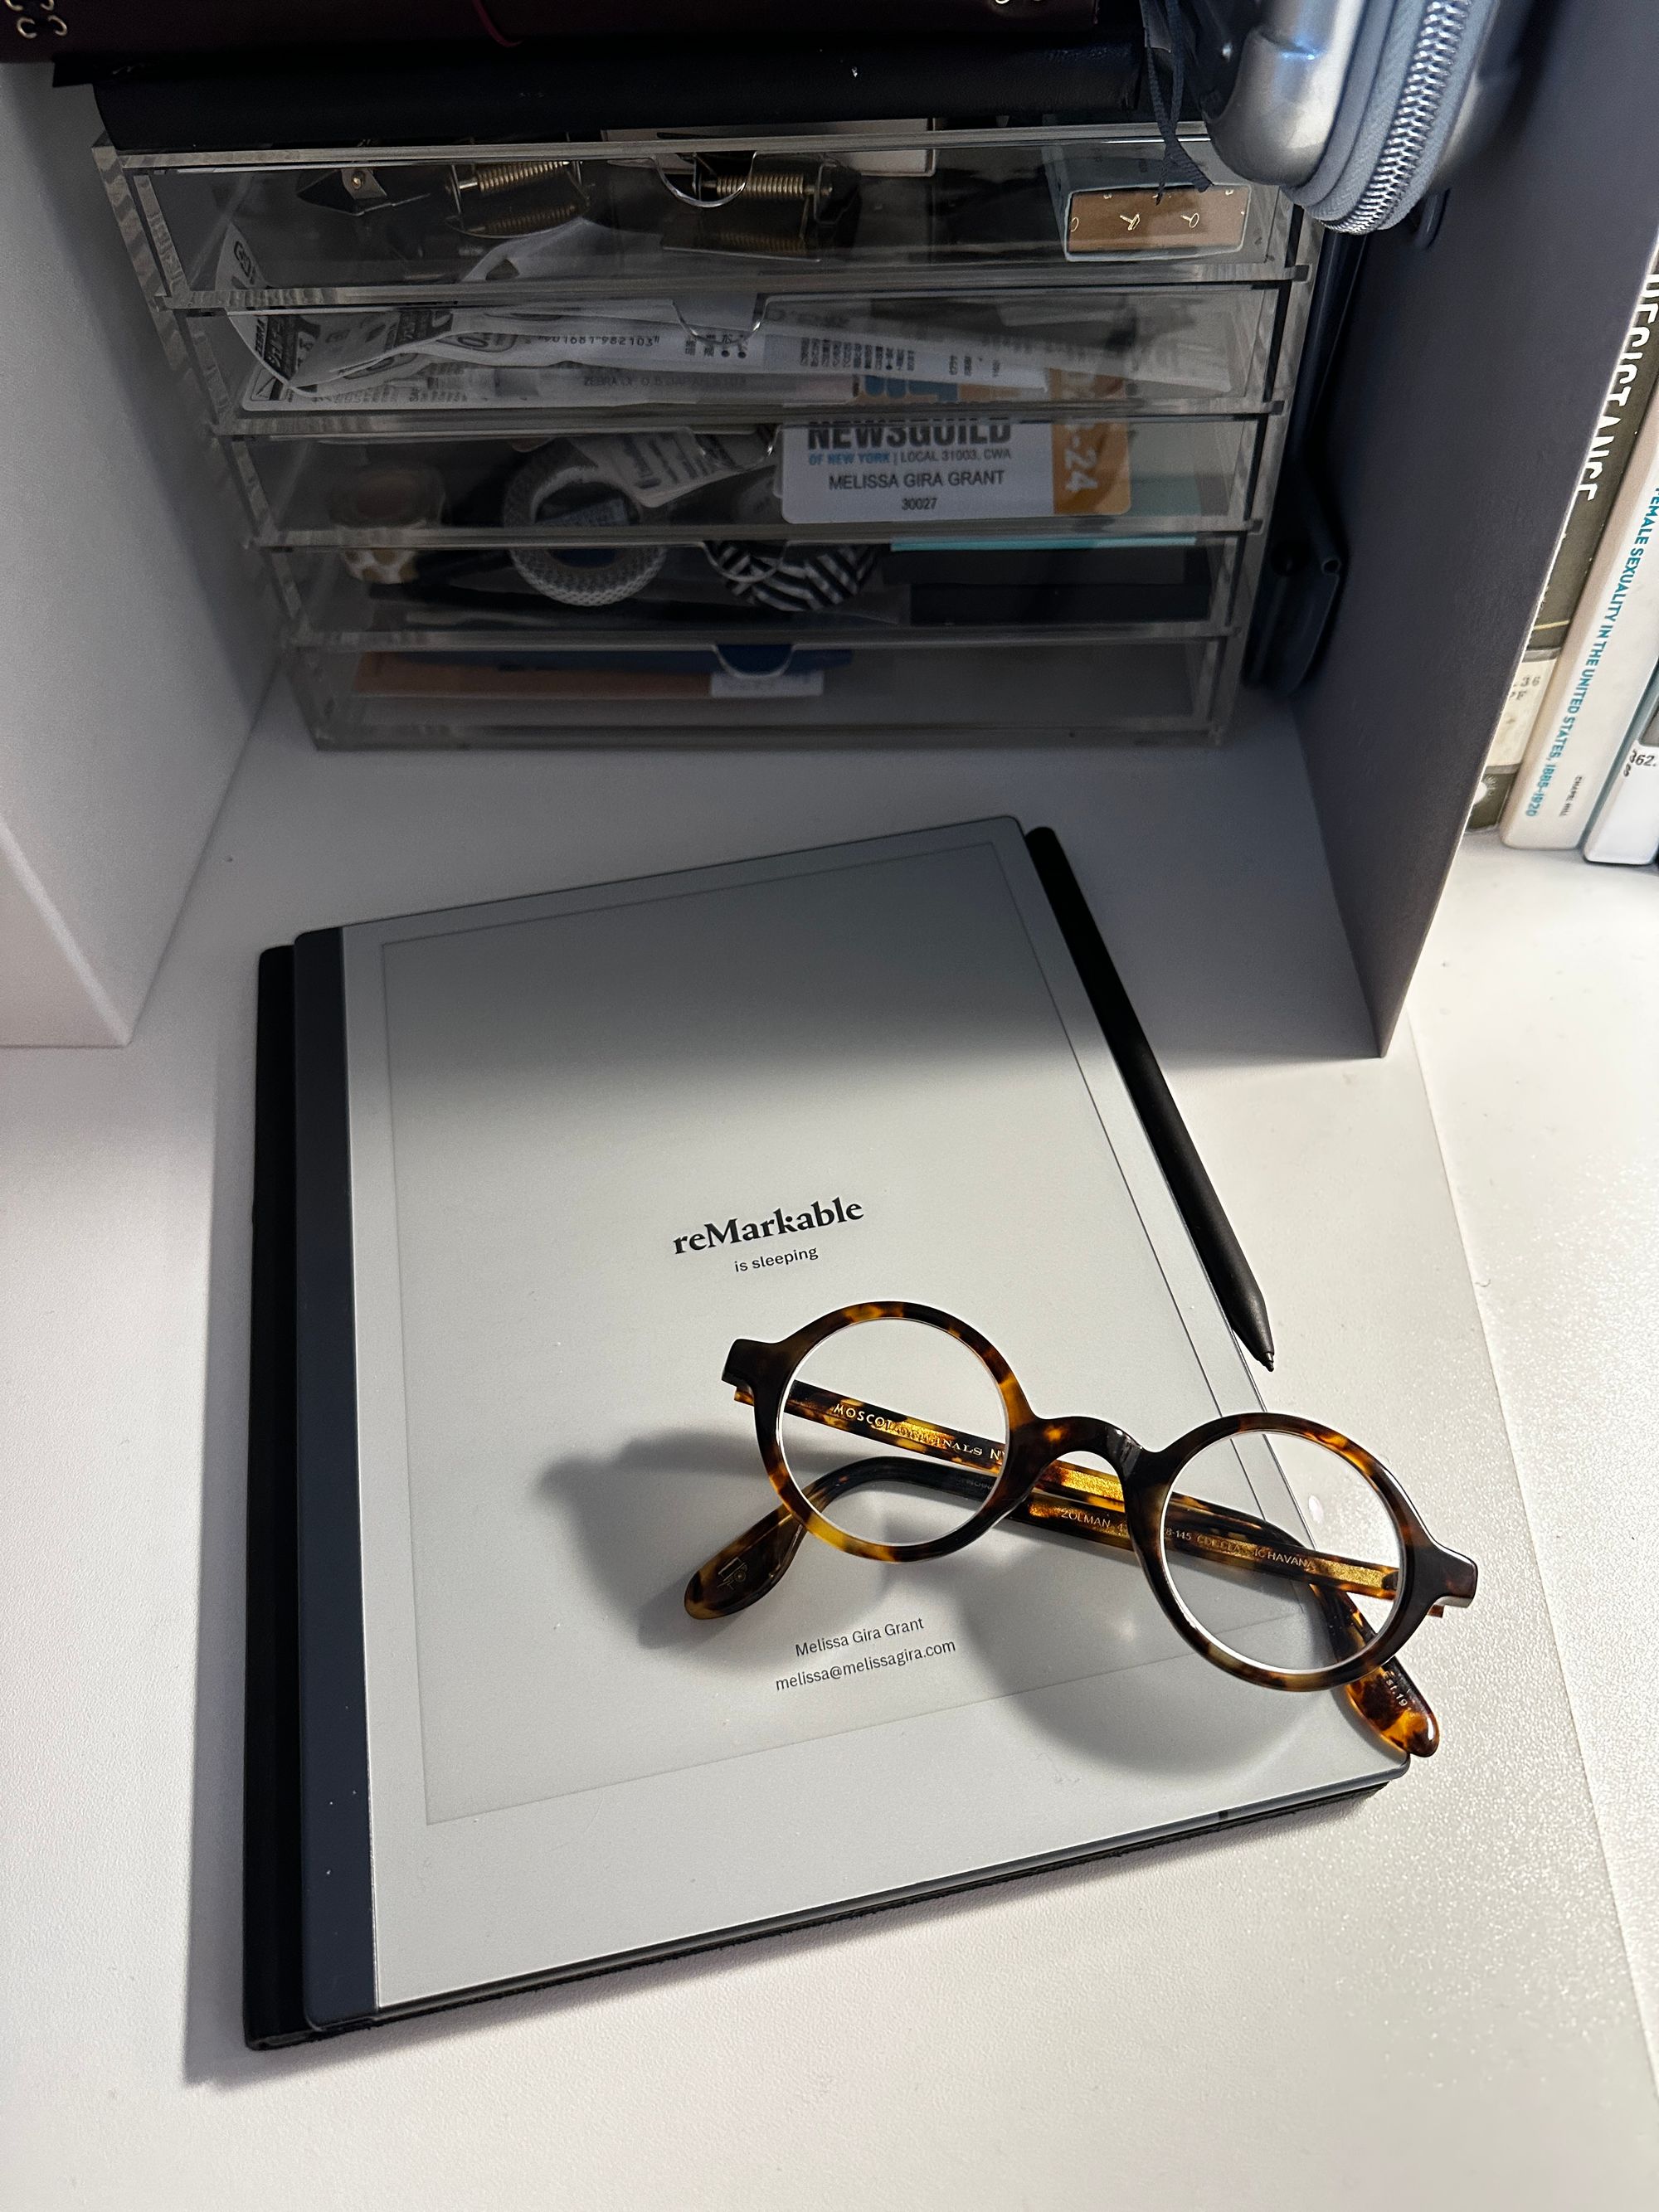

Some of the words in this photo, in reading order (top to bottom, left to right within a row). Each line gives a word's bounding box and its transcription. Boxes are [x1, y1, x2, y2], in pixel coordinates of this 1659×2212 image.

[808, 417, 1011, 450] NEWSGUILD
[809, 453, 825, 465] OF
[827, 452, 854, 464] NEW
[859, 452, 890, 464] YORK
[901, 450, 938, 463] LOCAL
[984, 449, 1012, 460] CWA
[830, 474, 899, 490] MELISSA
[903, 472, 943, 488] GIRA
[948, 469, 1005, 486] GRANT
[902, 498, 937, 511] 30027
[1604, 547, 1644, 622] SEXUALITY
[1597, 625, 1613, 639] IN
[1585, 641, 1608, 666] THE
[1566, 668, 1596, 713] UNITED
[1546, 716, 1576, 761] STATES,
[673, 1196, 864, 1255] reMarkable
[734, 1260, 748, 1272] is
[752, 1247, 819, 1270] sleeping
[833, 1403, 893, 1431] MOSCOT
[1061, 1510, 1112, 1529] ZOLMAN
[1267, 1551, 1316, 1569] HAVANA
[795, 1635, 849, 1657] Melissa
[852, 1628, 882, 1644] Gira
[884, 1617, 925, 1636] Grant
[776, 1641, 956, 1691] melissa@melissagira.com
